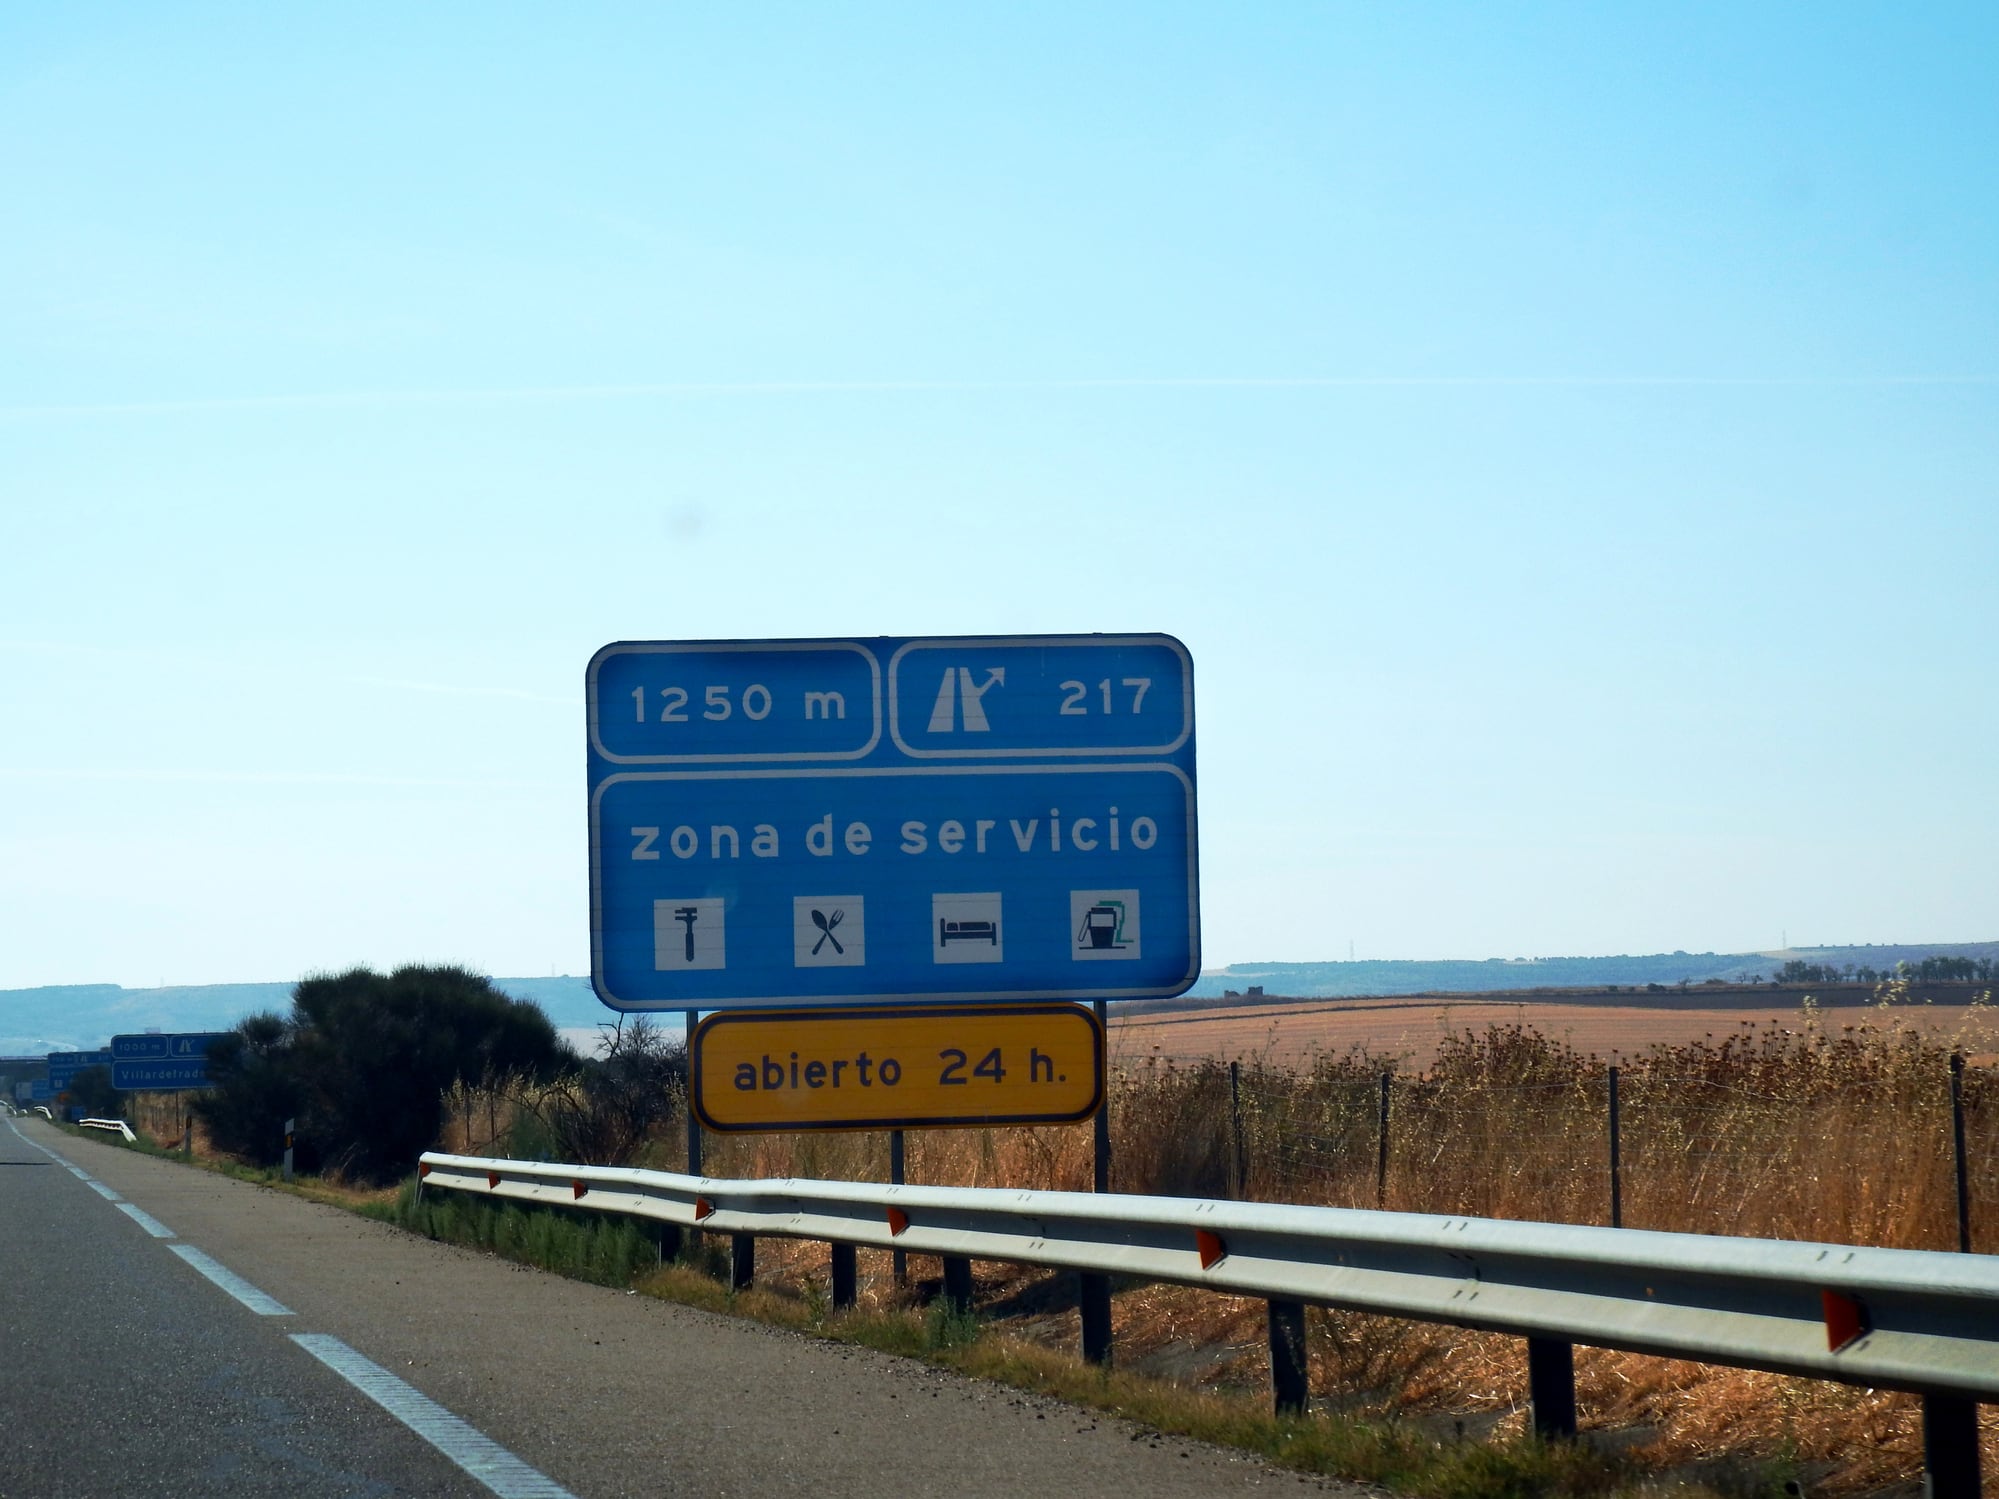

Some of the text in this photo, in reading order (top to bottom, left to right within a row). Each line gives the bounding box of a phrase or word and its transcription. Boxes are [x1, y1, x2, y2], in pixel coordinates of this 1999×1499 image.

[630, 684, 847, 723] 1250 m
[1058, 677, 1153, 715] 217
[630, 807, 1158, 861] zona de servicio
[119, 1043, 147, 1052] 1000
[733, 1047, 1067, 1091] abierto 24 h.
